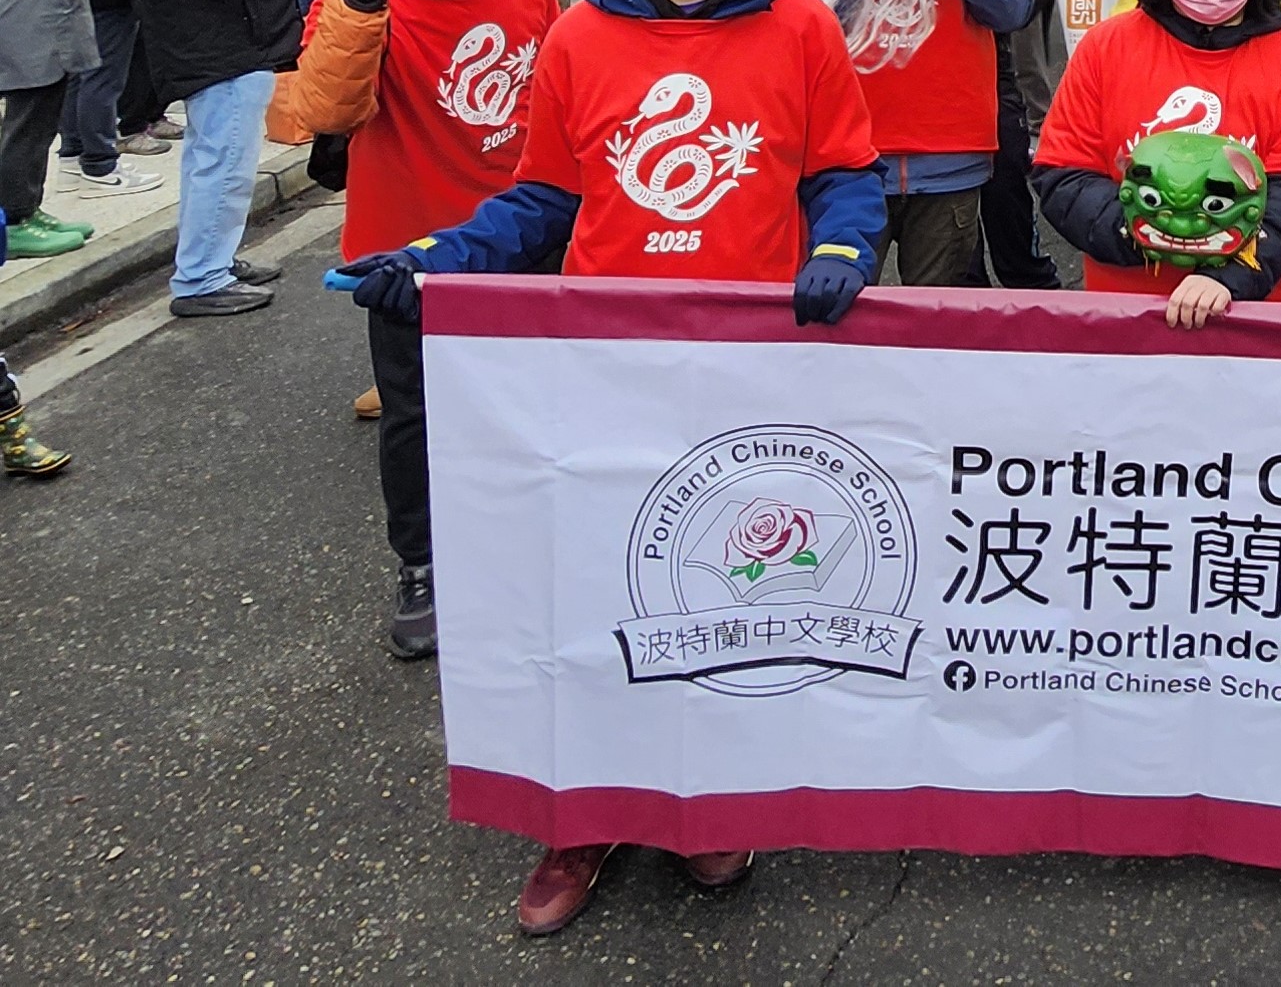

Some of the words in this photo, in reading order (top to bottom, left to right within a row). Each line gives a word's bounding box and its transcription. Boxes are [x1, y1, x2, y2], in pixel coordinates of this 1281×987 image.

[482, 123, 517, 153] 2025
[644, 230, 702, 252] 2025
[951, 446, 1233, 501] Portland
[643, 455, 723, 560] Portland
[731, 438, 844, 474] Chinese
[850, 471, 902, 560] School
[636, 612, 899, 664] 波特蘭中文學校
[985, 670, 1096, 691] Portland
[1105, 671, 1212, 693] Chinese
